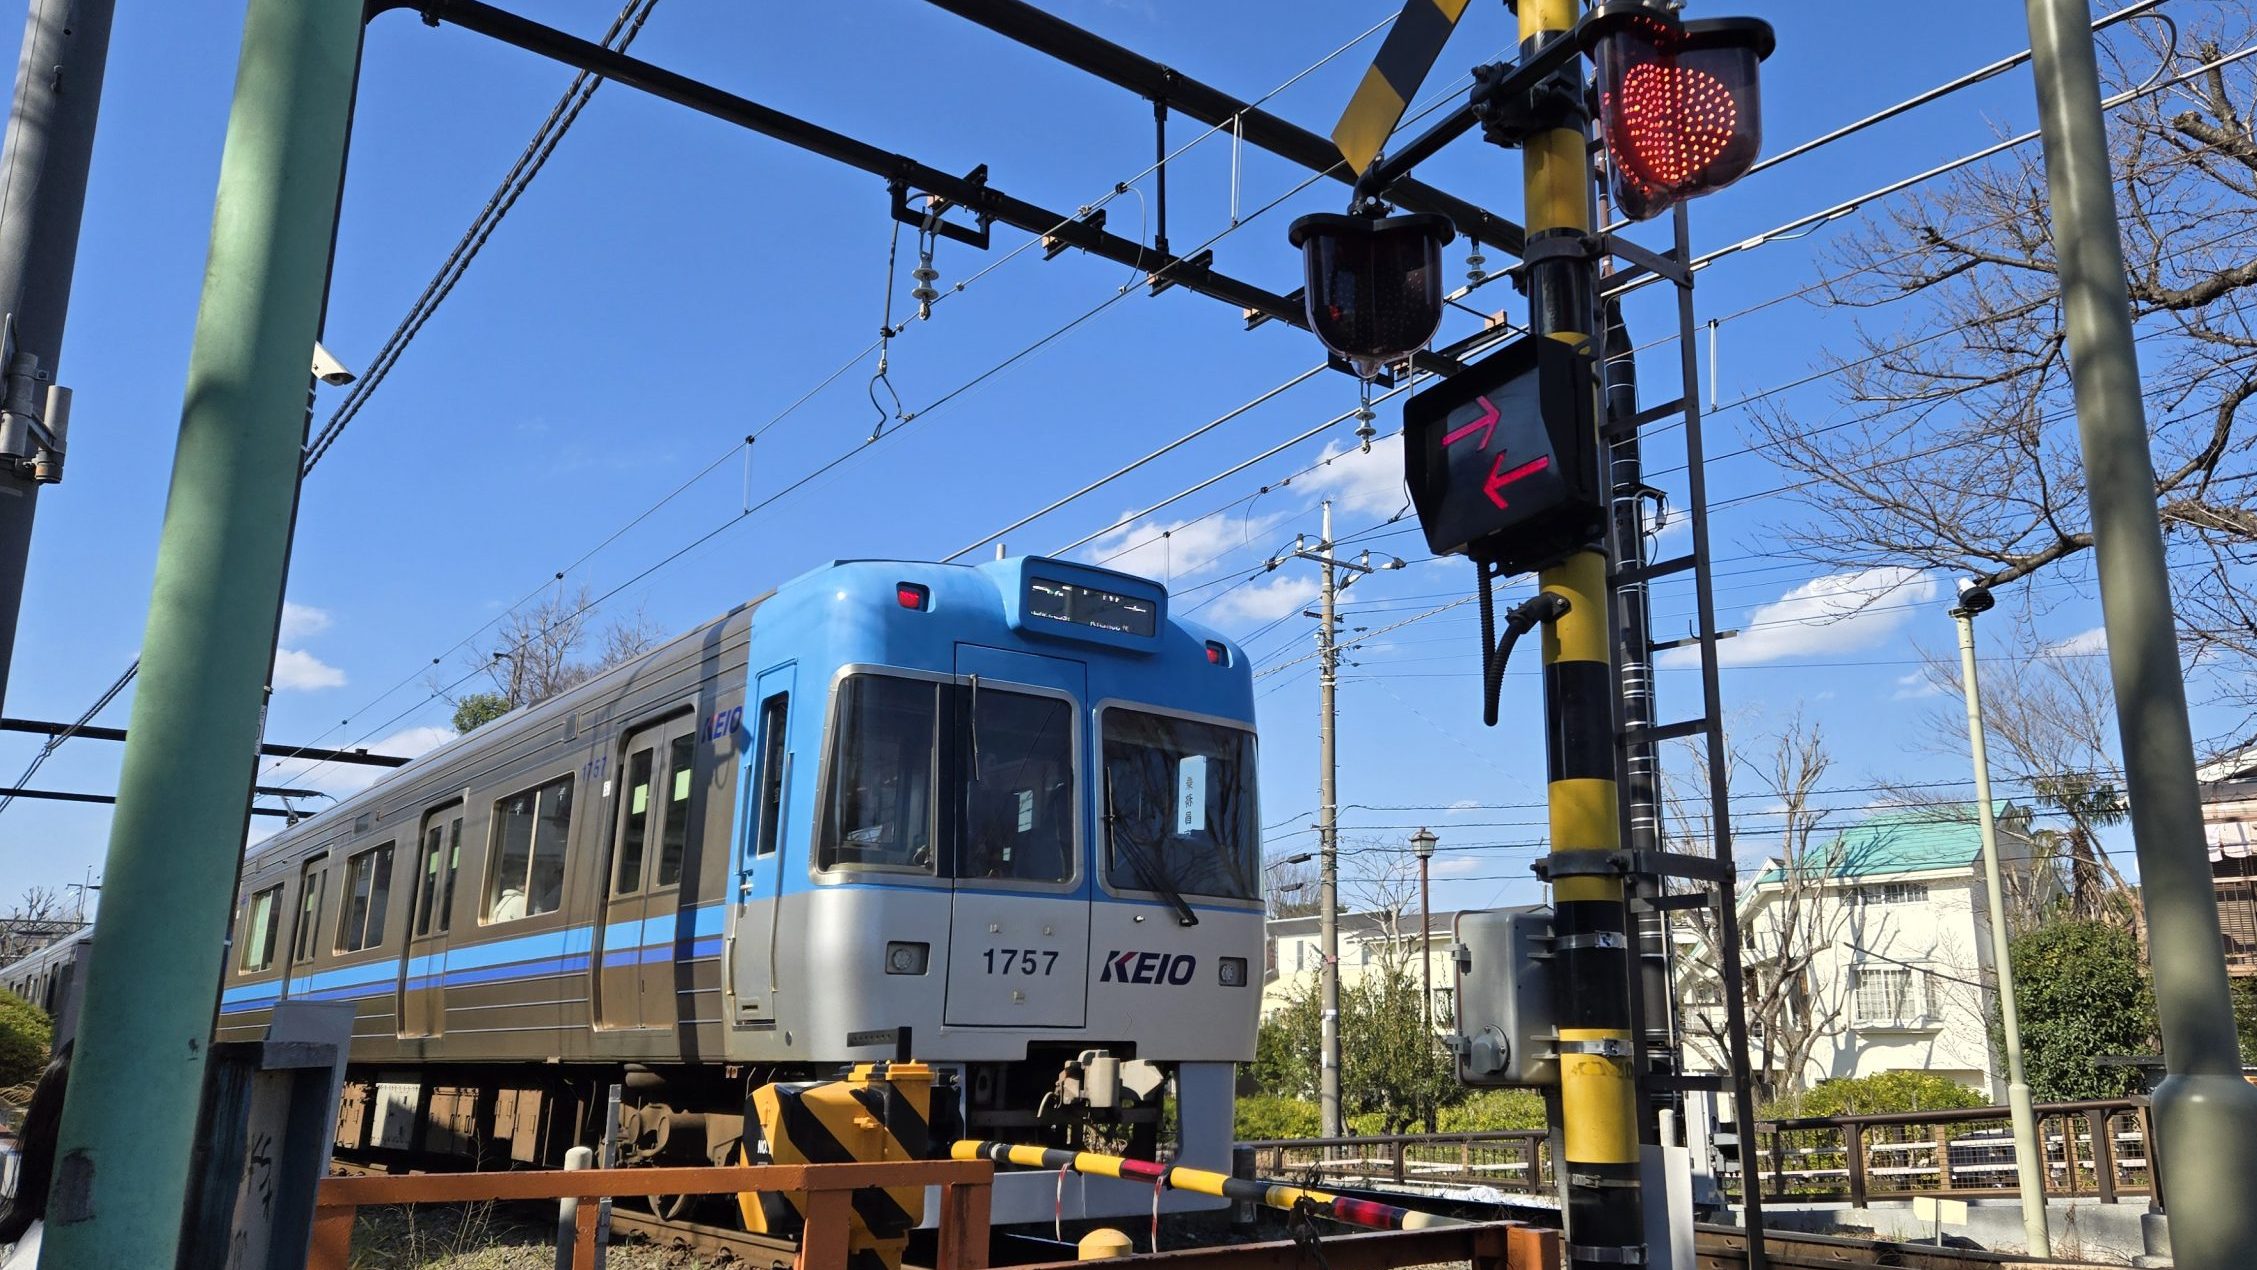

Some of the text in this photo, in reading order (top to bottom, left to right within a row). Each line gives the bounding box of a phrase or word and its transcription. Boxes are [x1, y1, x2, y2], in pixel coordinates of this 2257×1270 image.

[701, 705, 742, 744] KEIO
[582, 755, 607, 781] 1757
[983, 948, 1060, 976] 1757
[1099, 950, 1197, 986] KEIO
